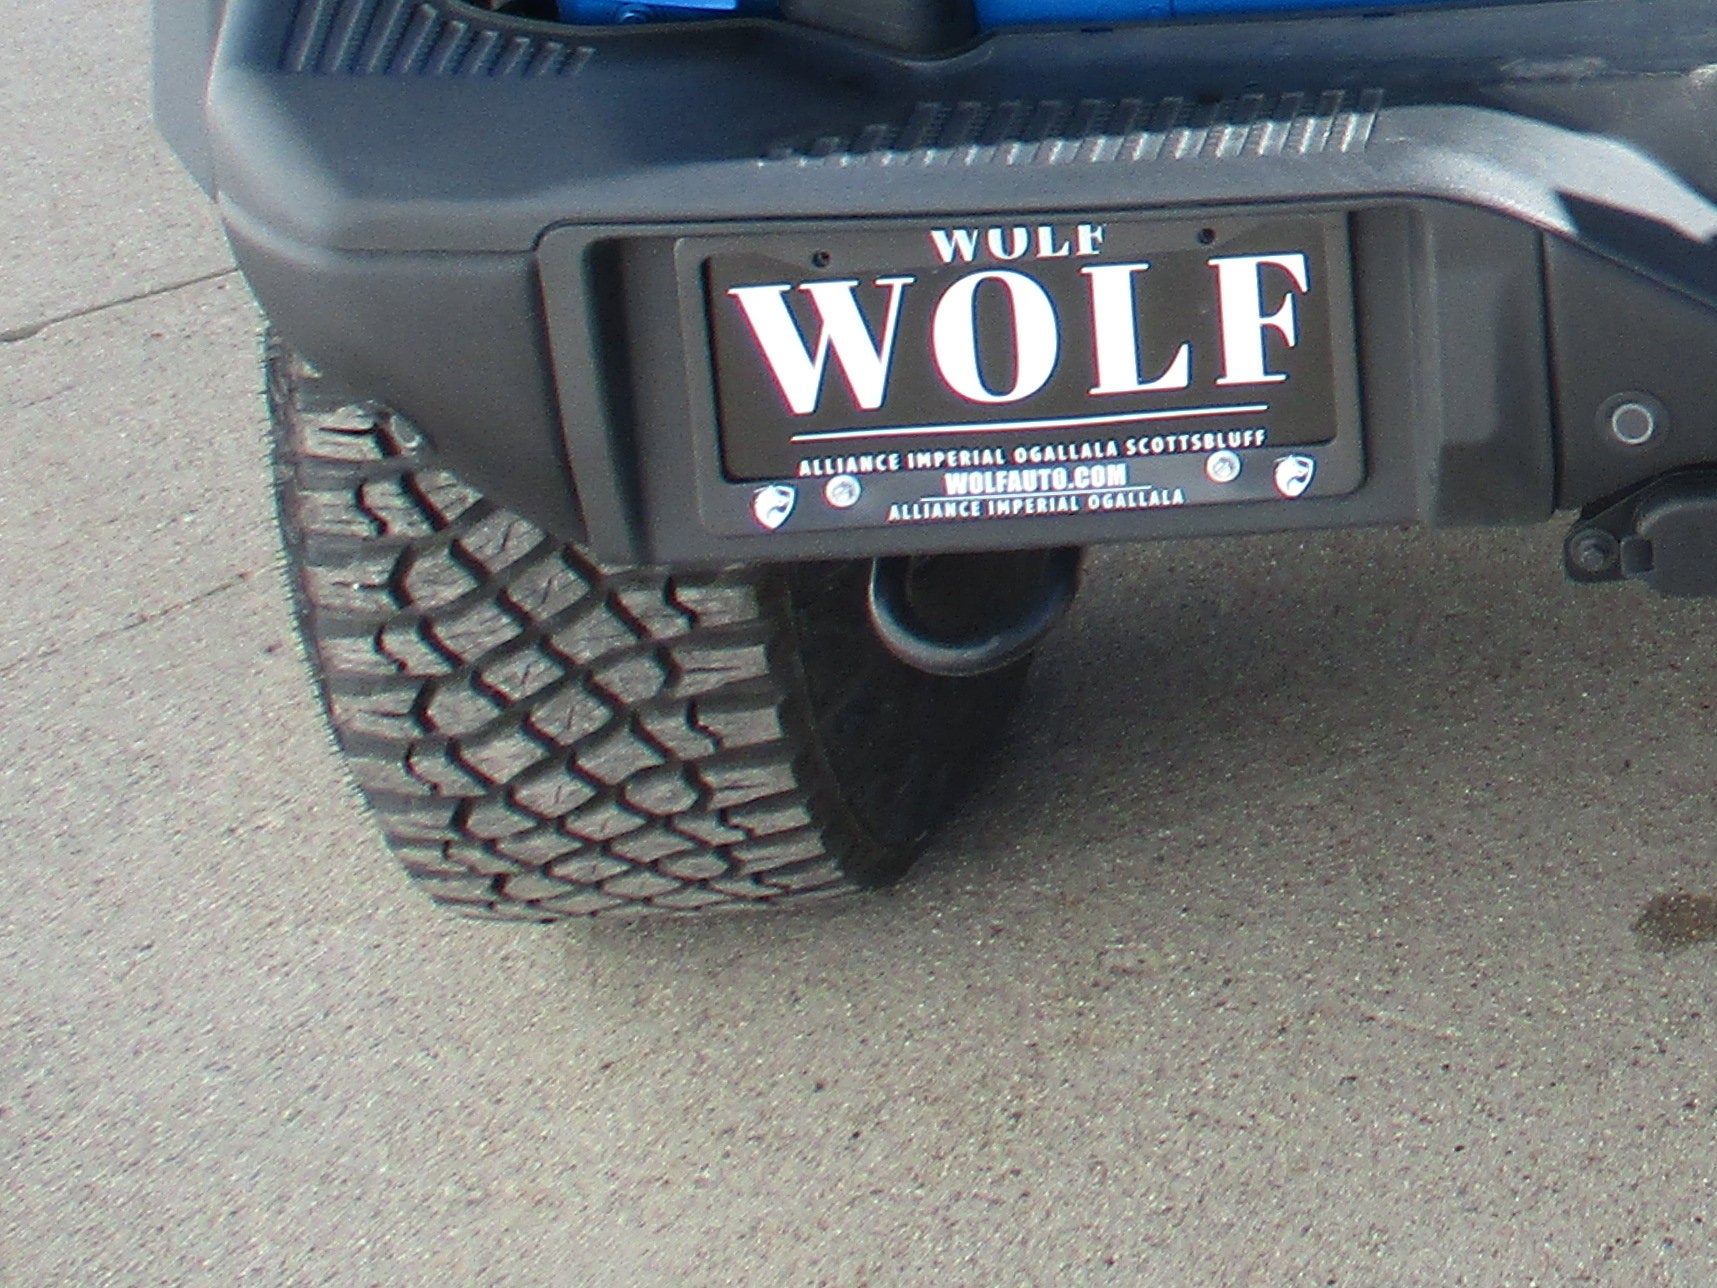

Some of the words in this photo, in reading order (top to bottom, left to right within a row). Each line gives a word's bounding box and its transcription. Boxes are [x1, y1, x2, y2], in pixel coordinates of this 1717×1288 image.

[727, 252, 1310, 416] WOLF
[798, 453, 901, 477] ALLIANCE
[906, 448, 1005, 470] IMPERIAL
[1013, 440, 1118, 464] OGALLALA
[1124, 428, 1268, 456] SCOTTSBLUFF
[942, 462, 1128, 497] WOLFAUTO.COM
[886, 501, 982, 523] ALLIANCE
[986, 494, 1079, 516] IMPERIAL
[1087, 487, 1186, 511] OGALLALA
